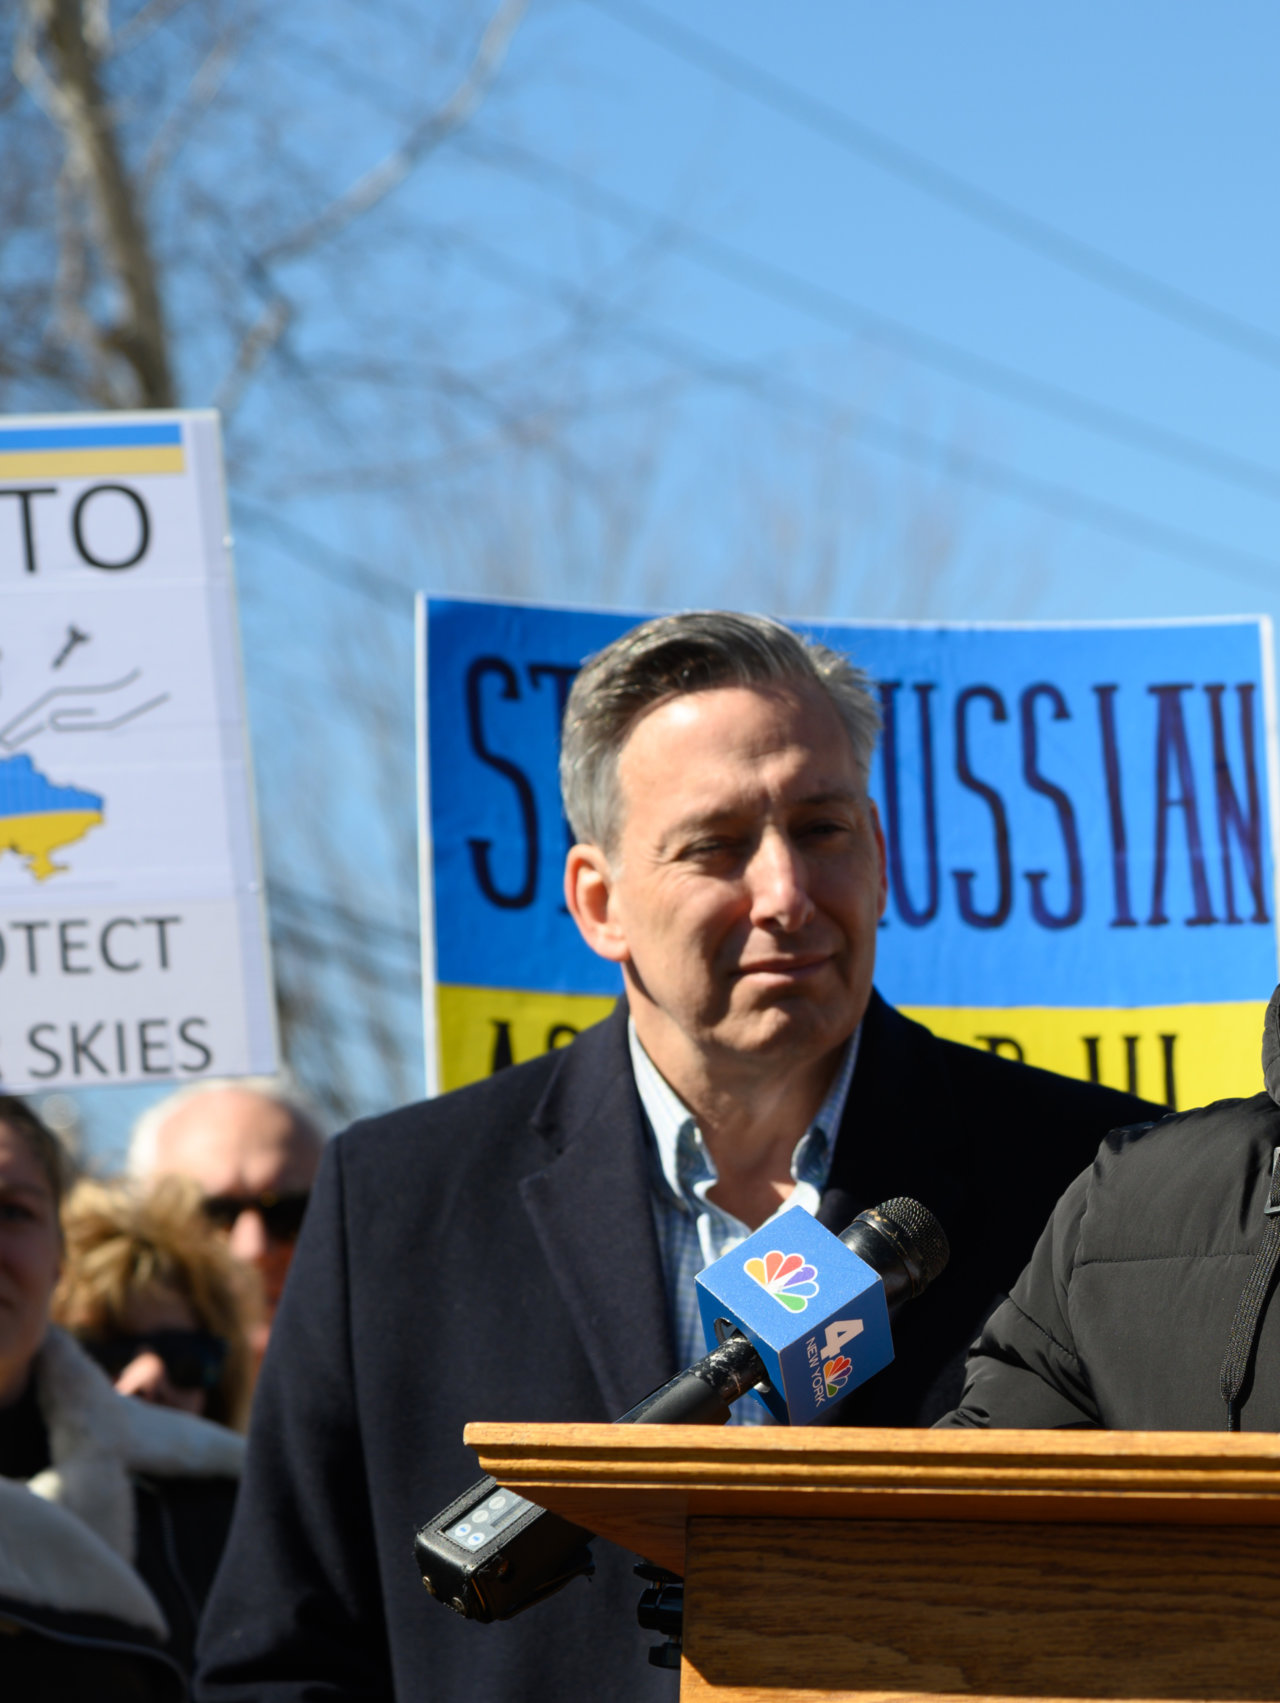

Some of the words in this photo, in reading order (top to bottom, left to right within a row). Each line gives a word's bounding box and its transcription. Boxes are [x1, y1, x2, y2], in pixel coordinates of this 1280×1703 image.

[880, 683, 1271, 930] USSIAN
[0, 916, 182, 976] TECT
[27, 1017, 212, 1079] SKIES
[806, 1337, 820, 1367] NEW
[821, 1319, 864, 1360] 4
[811, 1368, 826, 1408] YORK
